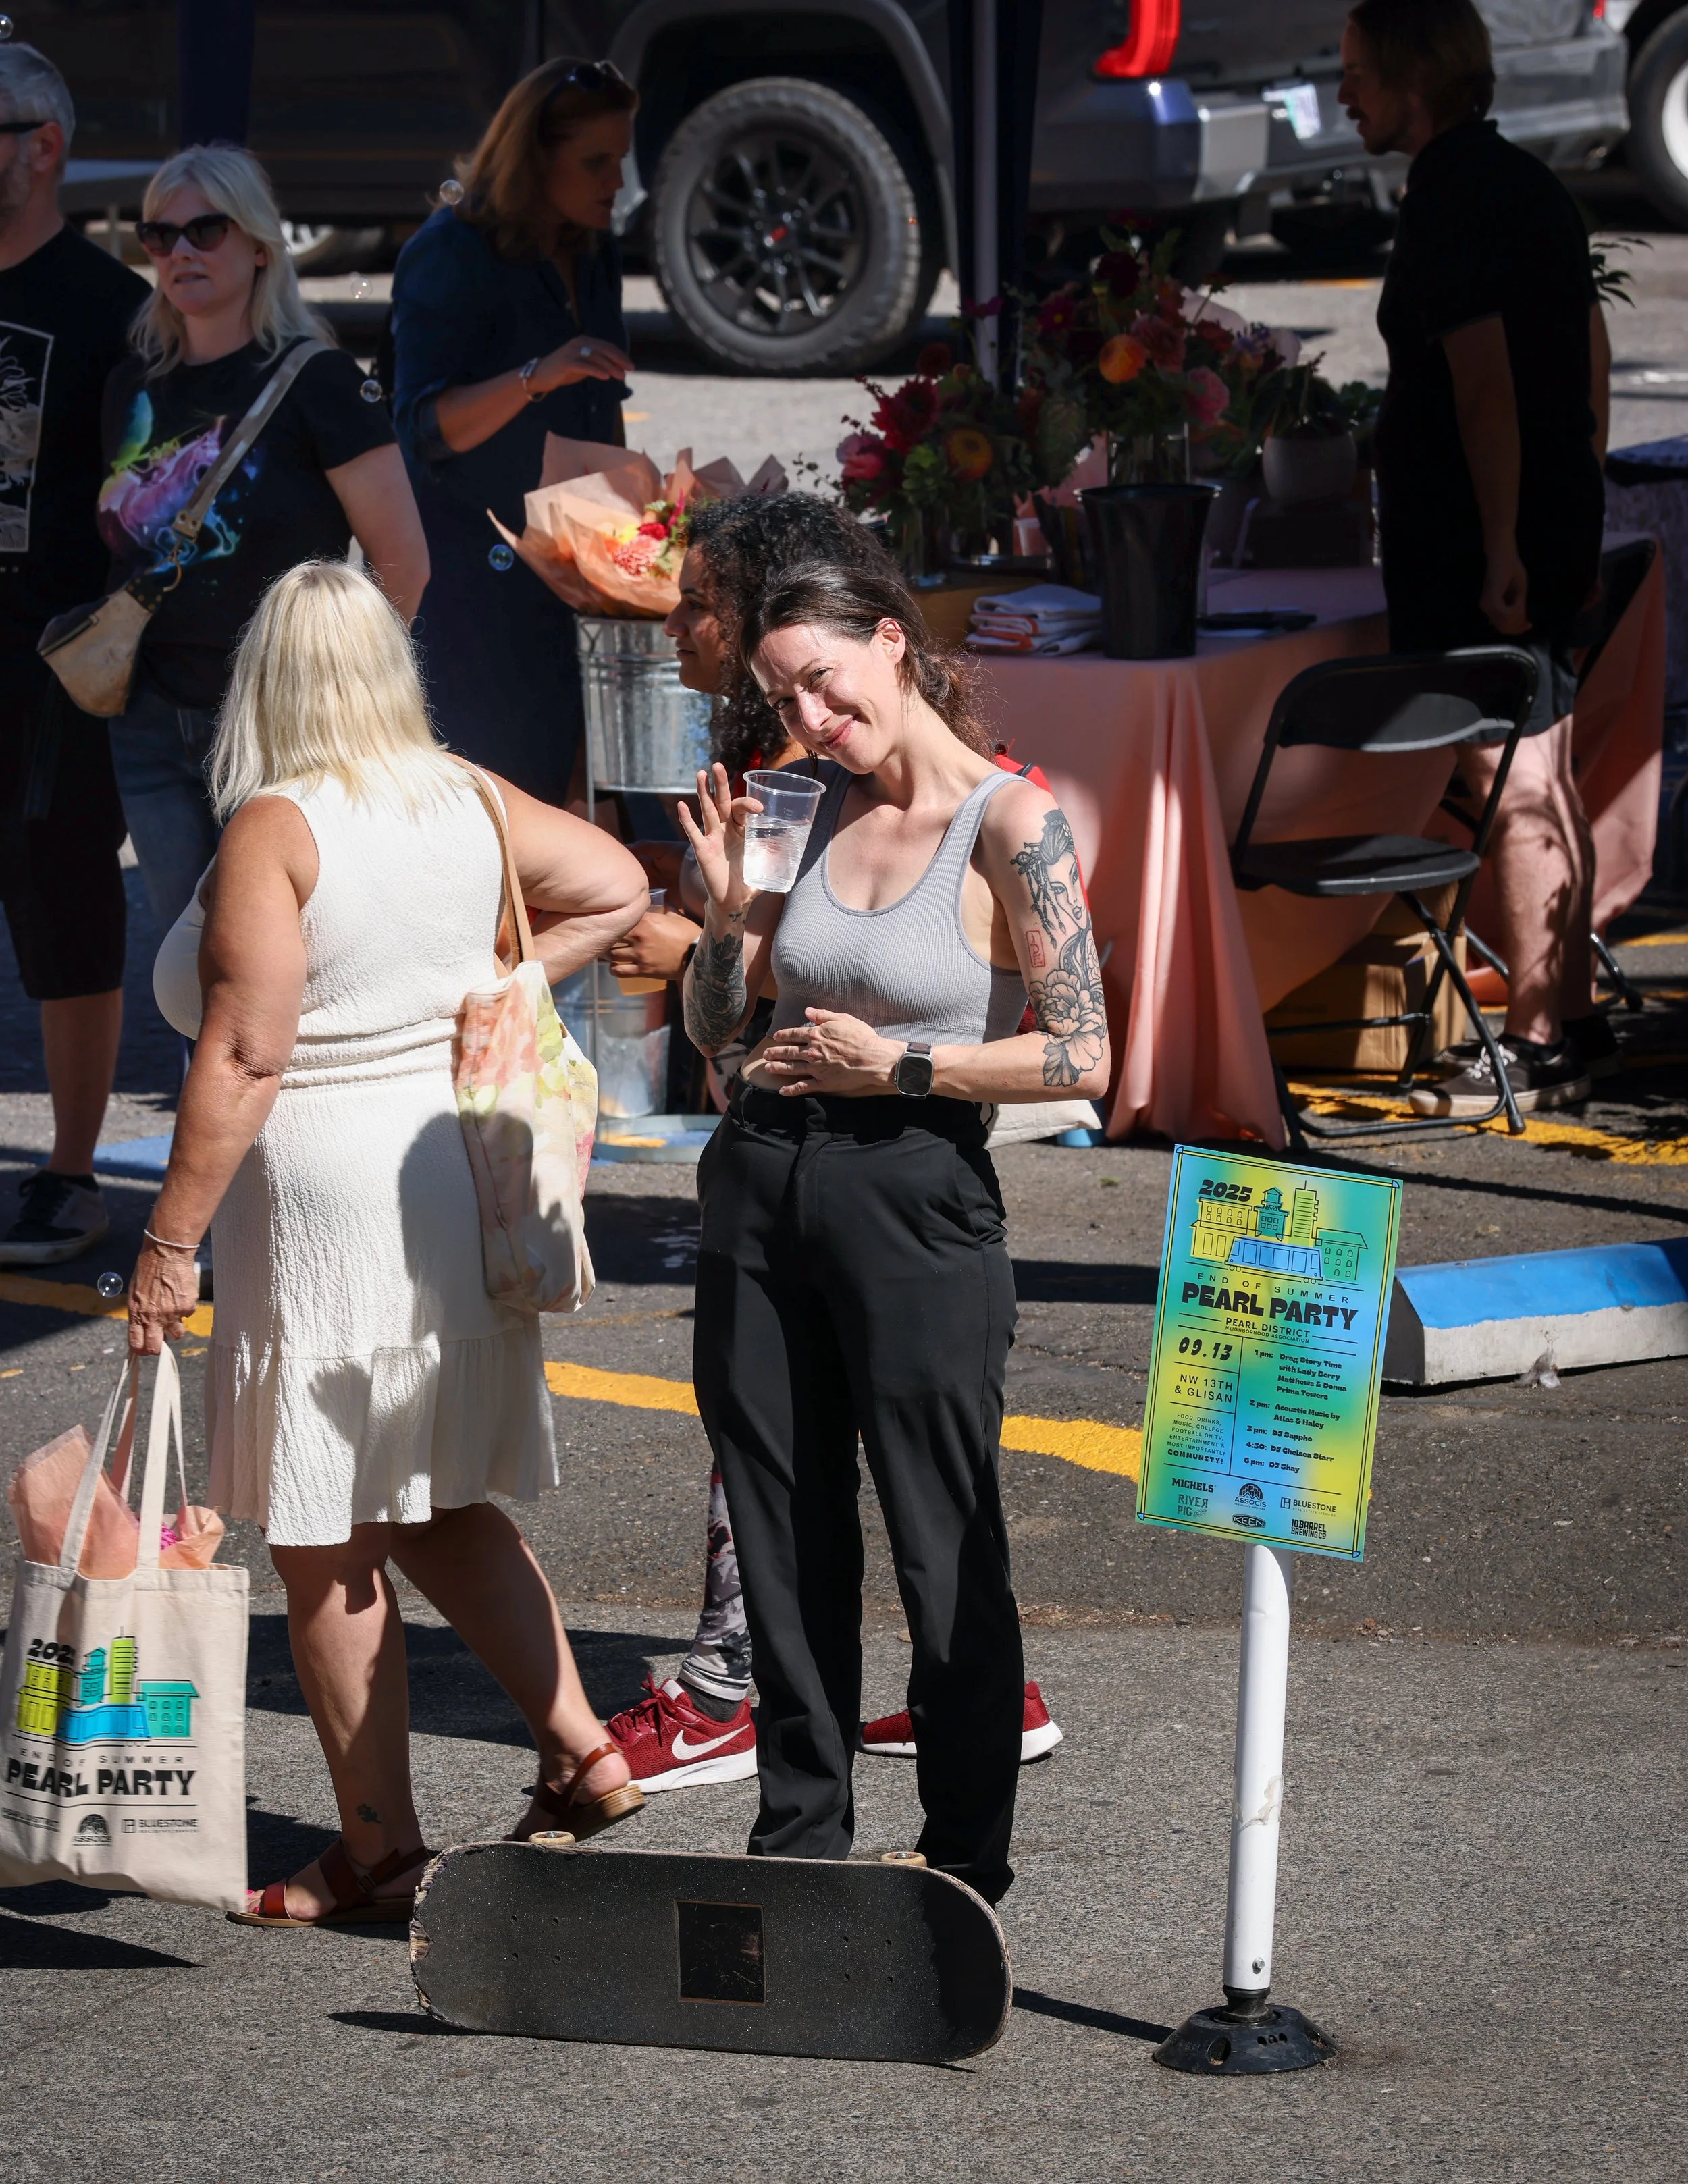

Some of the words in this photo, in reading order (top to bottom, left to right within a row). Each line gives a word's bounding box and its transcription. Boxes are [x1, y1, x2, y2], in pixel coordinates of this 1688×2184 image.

[1198, 1179, 1253, 1202] 2025
[1197, 1273, 1229, 1284] END
[1242, 1281, 1261, 1290] OF
[1274, 1286, 1349, 1304] SUMMER
[1182, 1281, 1264, 1316] PEARL
[1269, 1297, 1359, 1330] PARTY
[1225, 1317, 1257, 1330] PEARL
[1261, 1323, 1310, 1337] DISTRICT
[1225, 1326, 1269, 1337] NEIGHBORHOOD
[1271, 1333, 1310, 1343] ASSOCIATION
[1178, 1337, 1233, 1361] 09.13
[1280, 1353, 1298, 1364] Drag
[1300, 1356, 1322, 1367] Story
[1323, 1360, 1342, 1369] Time
[1297, 1367, 1317, 1377] Lady
[1318, 1370, 1340, 1381] Berry
[1180, 1374, 1198, 1385] NW
[1203, 1378, 1233, 1391] 13TH
[1277, 1375, 1315, 1387] Matthews
[1323, 1382, 1347, 1392] Donna
[1175, 1385, 1182, 1395] &
[1187, 1387, 1232, 1404] GLISAN
[1276, 1386, 1300, 1395] Prima
[1301, 1389, 1329, 1400] Towers
[1275, 1404, 1307, 1414] Acoustic
[1307, 1409, 1329, 1418] Music
[1330, 1412, 1340, 1422] by
[1196, 1424, 1224, 1433] COLLEGE
[1197, 1416, 1221, 1426] DRINKS,
[1273, 1414, 1294, 1424] Atlas
[1302, 1419, 1324, 1430] Haley
[1171, 1427, 1203, 1437] FOOTBALL
[1284, 1431, 1313, 1442] Sappho
[1169, 1434, 1219, 1447] ENTERTAINMENT
[1167, 1449, 1224, 1464] COMMUNITY!
[1185, 1444, 1226, 1456] IMPORTANTLY
[1246, 1441, 1267, 1451] 4:30:
[1282, 1447, 1312, 1458] Chelsea
[1313, 1452, 1334, 1462] Starr
[1281, 1463, 1300, 1474] Shay
[1171, 1477, 1214, 1493] MICHELS
[1178, 1494, 1209, 1508] RIVER
[1234, 1497, 1267, 1508] ASSOCIS
[1293, 1499, 1337, 1513] BLUESTONE
[1177, 1505, 1194, 1516] PIG
[1233, 1516, 1264, 1526] KEEN
[64, 1759, 86, 1767] OF
[6, 1757, 90, 1799] PEARL
[96, 1769, 197, 1796] PARTY
